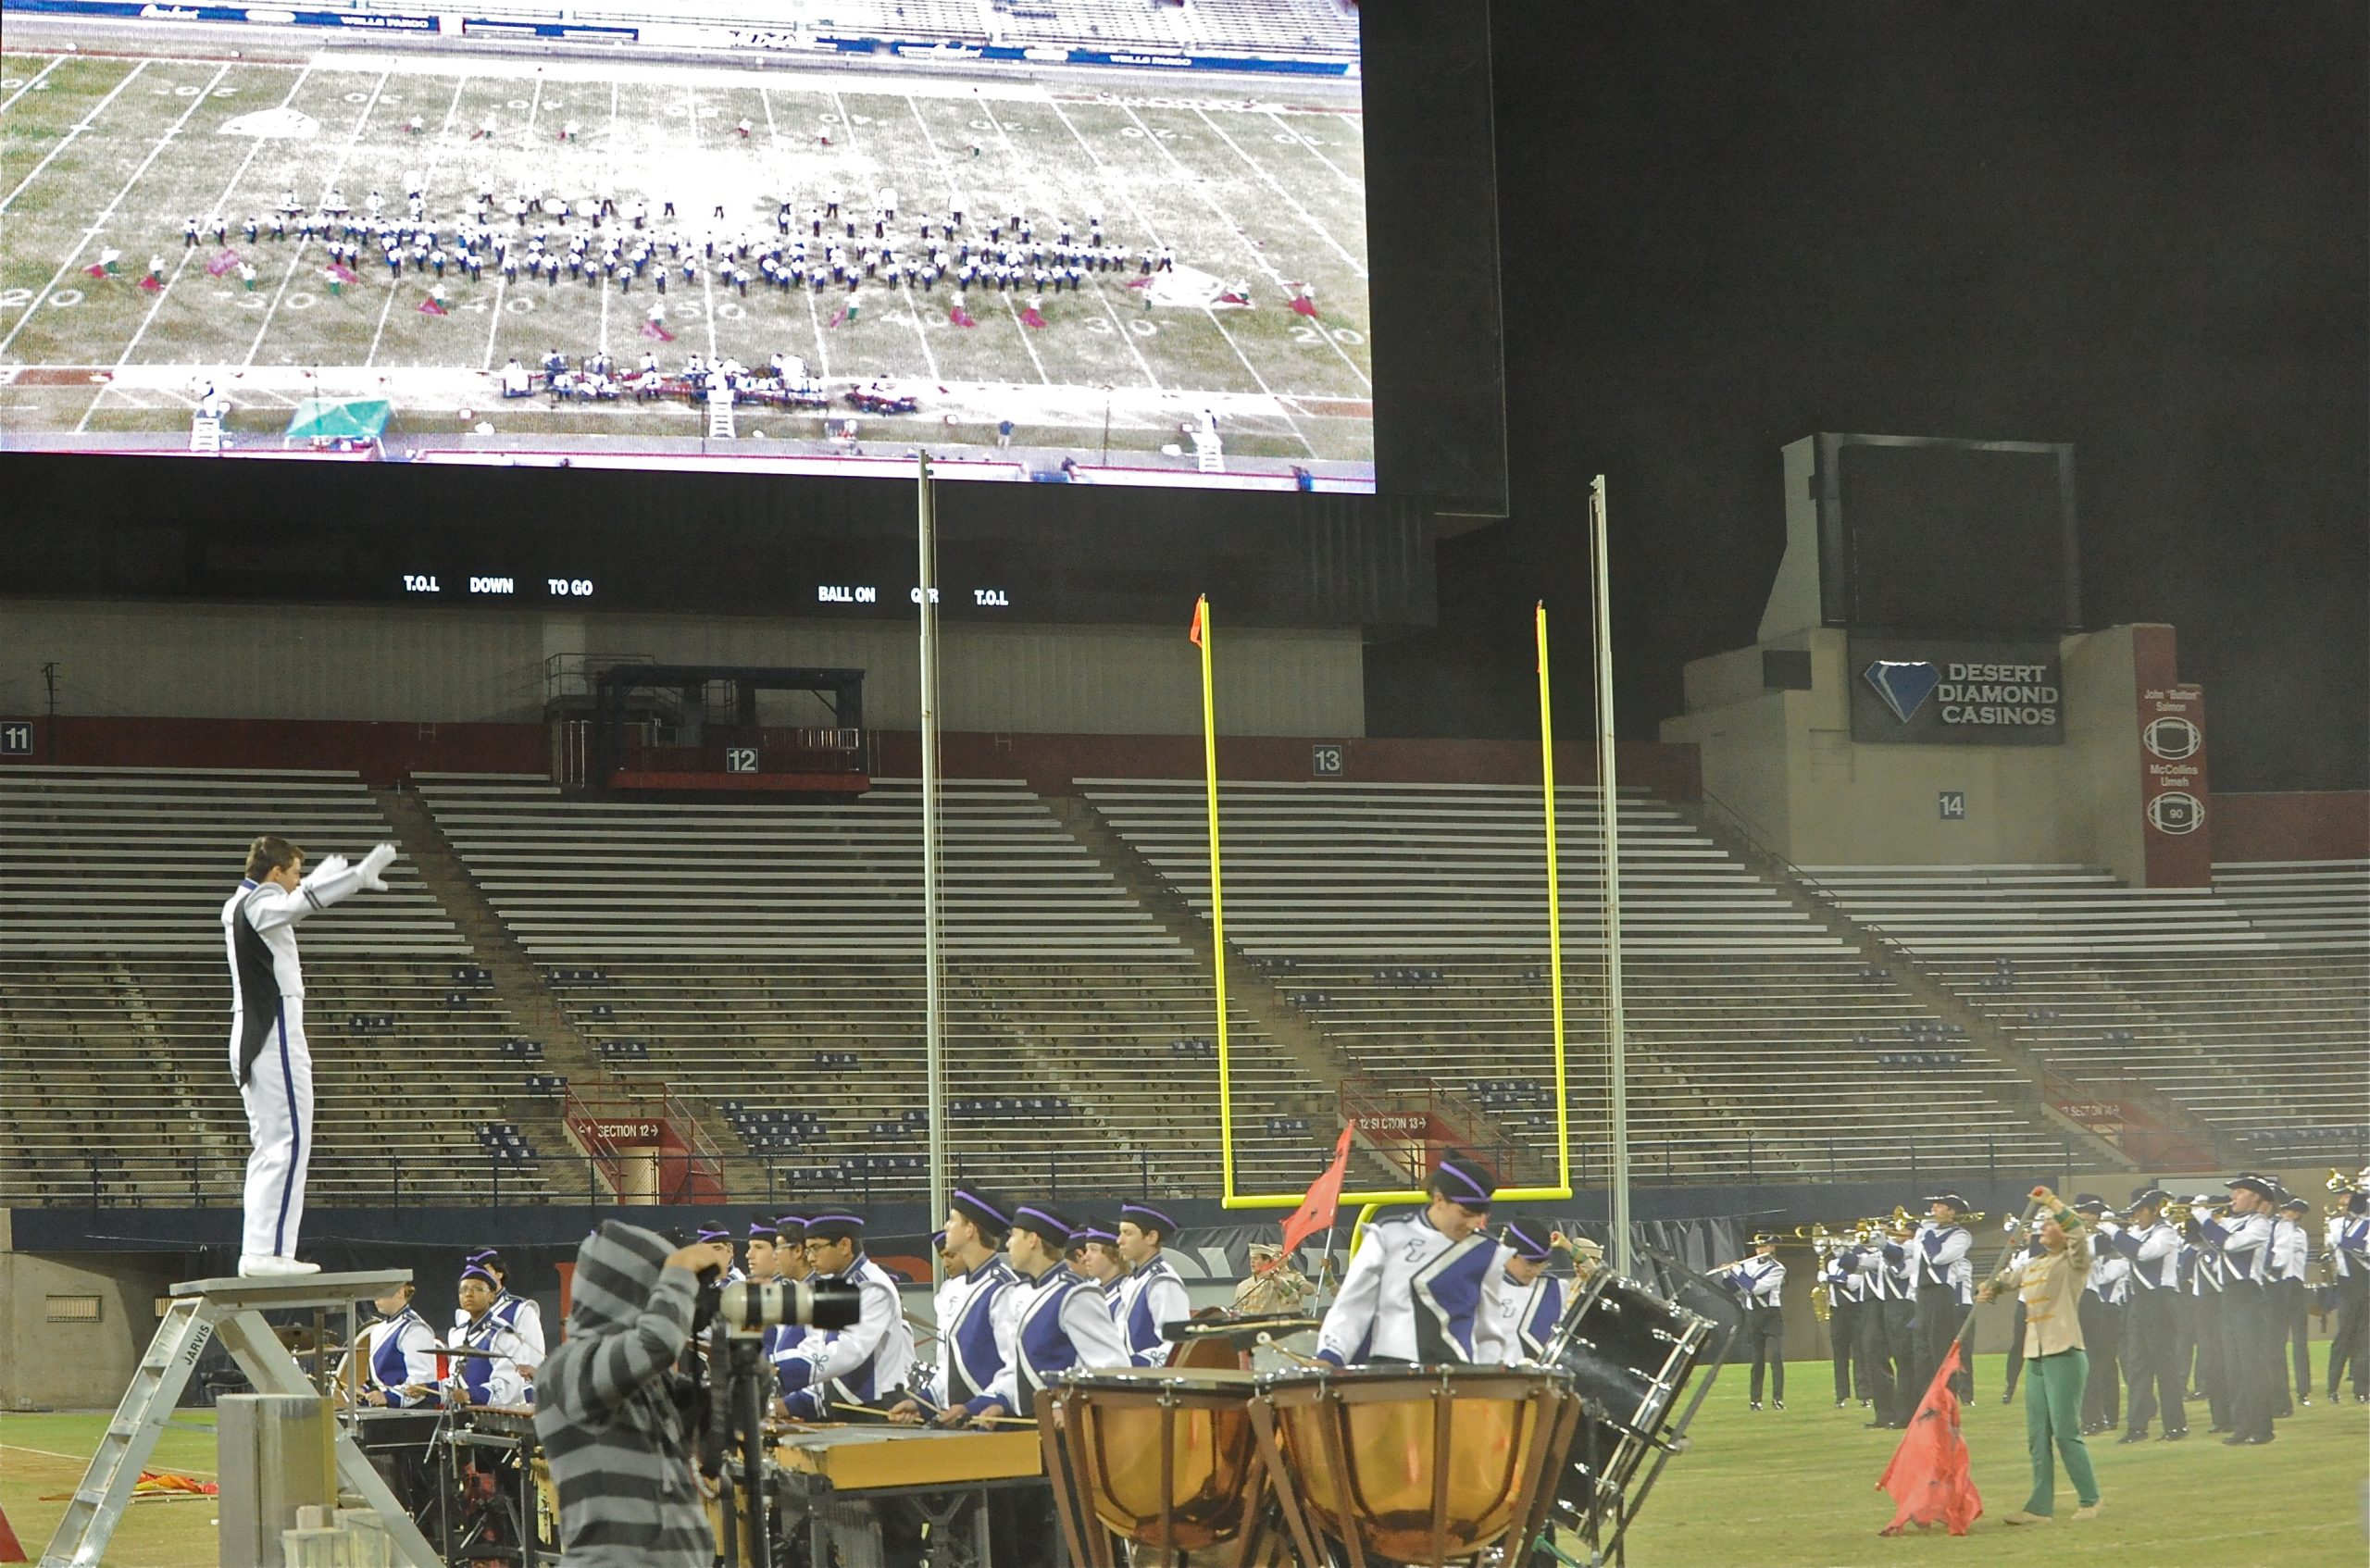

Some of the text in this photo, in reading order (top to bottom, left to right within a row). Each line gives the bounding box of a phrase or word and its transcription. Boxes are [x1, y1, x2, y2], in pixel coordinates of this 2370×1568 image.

[404, 575, 441, 592] T.O.L
[469, 577, 514, 593] DOWN
[548, 579, 593, 596] TO GO
[818, 586, 876, 603] BALL ON
[974, 590, 1009, 606] T.O.L
[1948, 663, 2047, 683] DESERT
[1938, 684, 2059, 704] DIAMOND
[1941, 705, 2056, 726] CASINOS
[6, 728, 27, 749] 11
[729, 750, 755, 771] 12
[1315, 750, 1341, 771] 13
[2150, 764, 2199, 776] McCollins
[1940, 795, 1964, 815] 14
[2169, 808, 2184, 819] 90
[597, 1124, 637, 1138] SECTION
[639, 1124, 650, 1137] 12
[1408, 1117, 1418, 1129] 13
[184, 1324, 211, 1366] JARVIS
